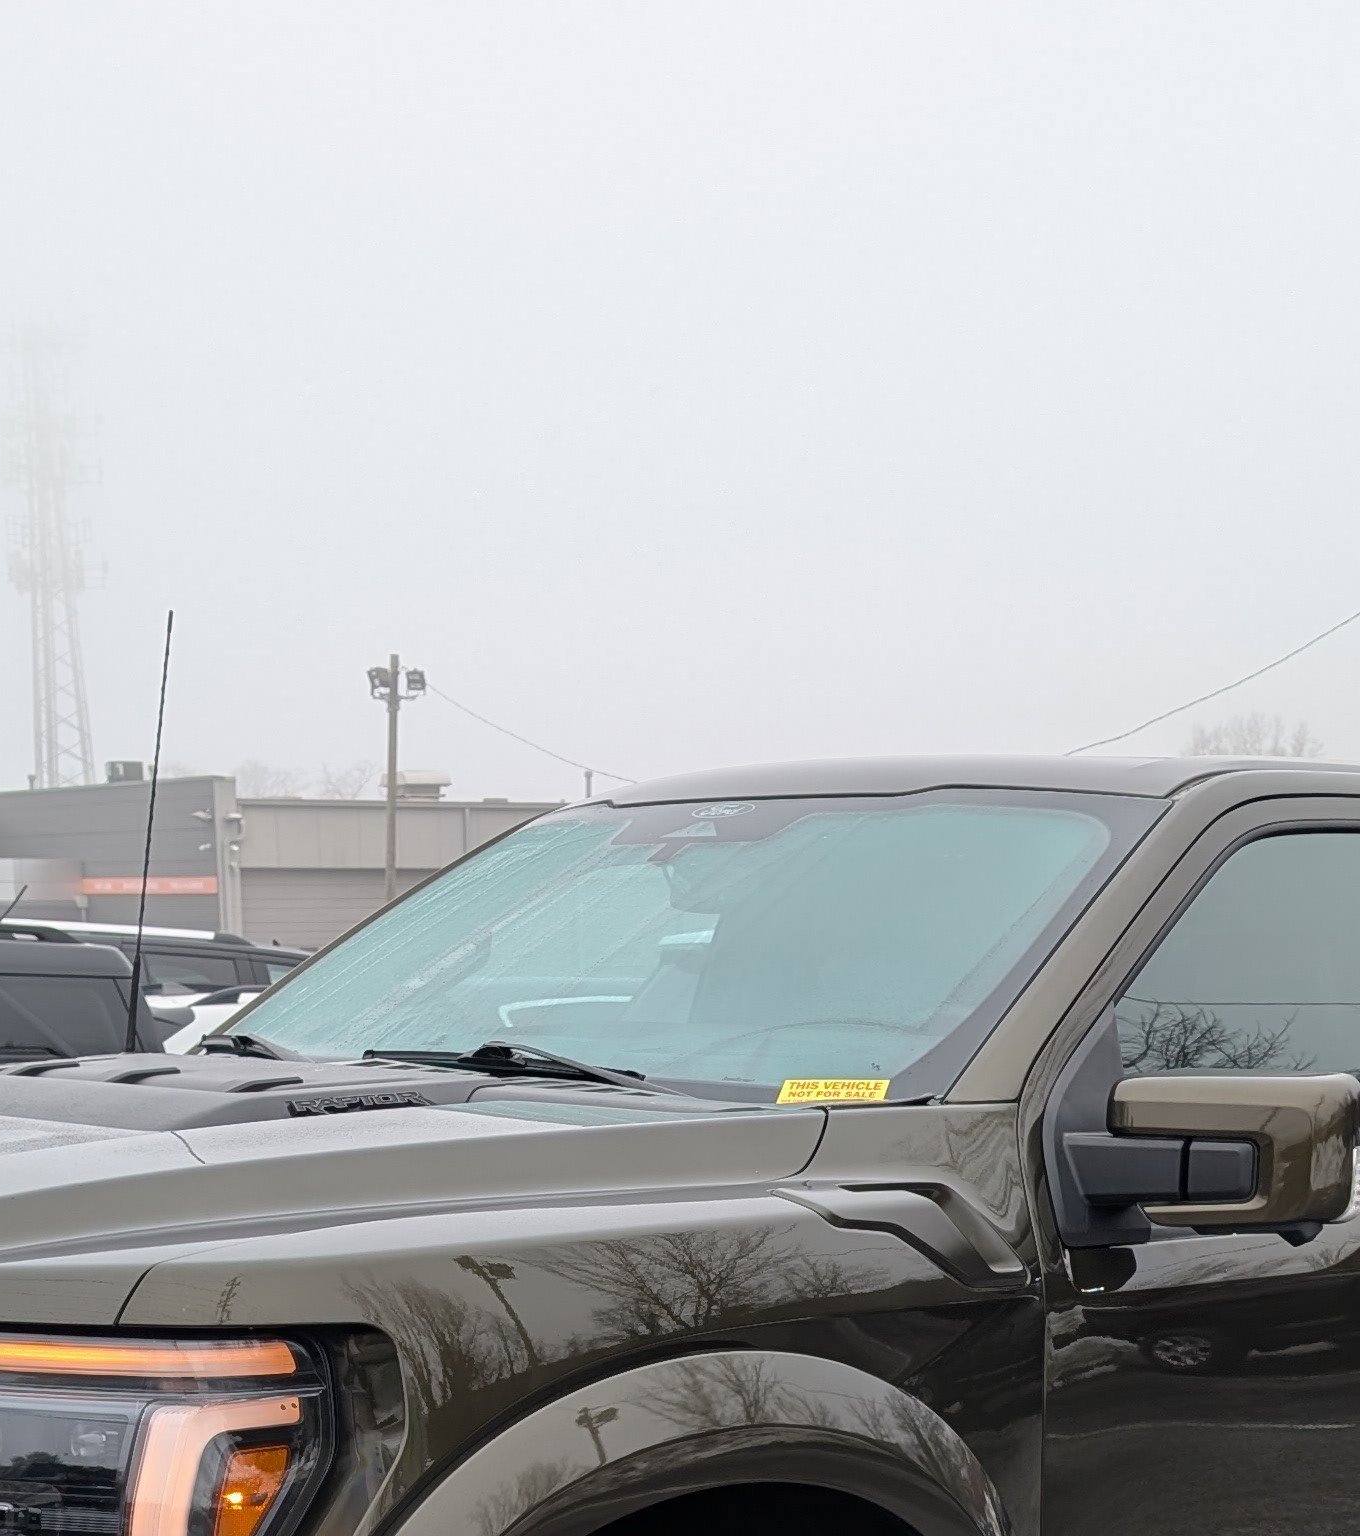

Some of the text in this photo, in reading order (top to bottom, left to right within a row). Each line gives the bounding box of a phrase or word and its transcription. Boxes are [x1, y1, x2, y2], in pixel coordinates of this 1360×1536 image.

[789, 1081, 883, 1091] THIS VEHICLE
[844, 1091, 877, 1099] SALE
[287, 1090, 431, 1115] RAPTOR
